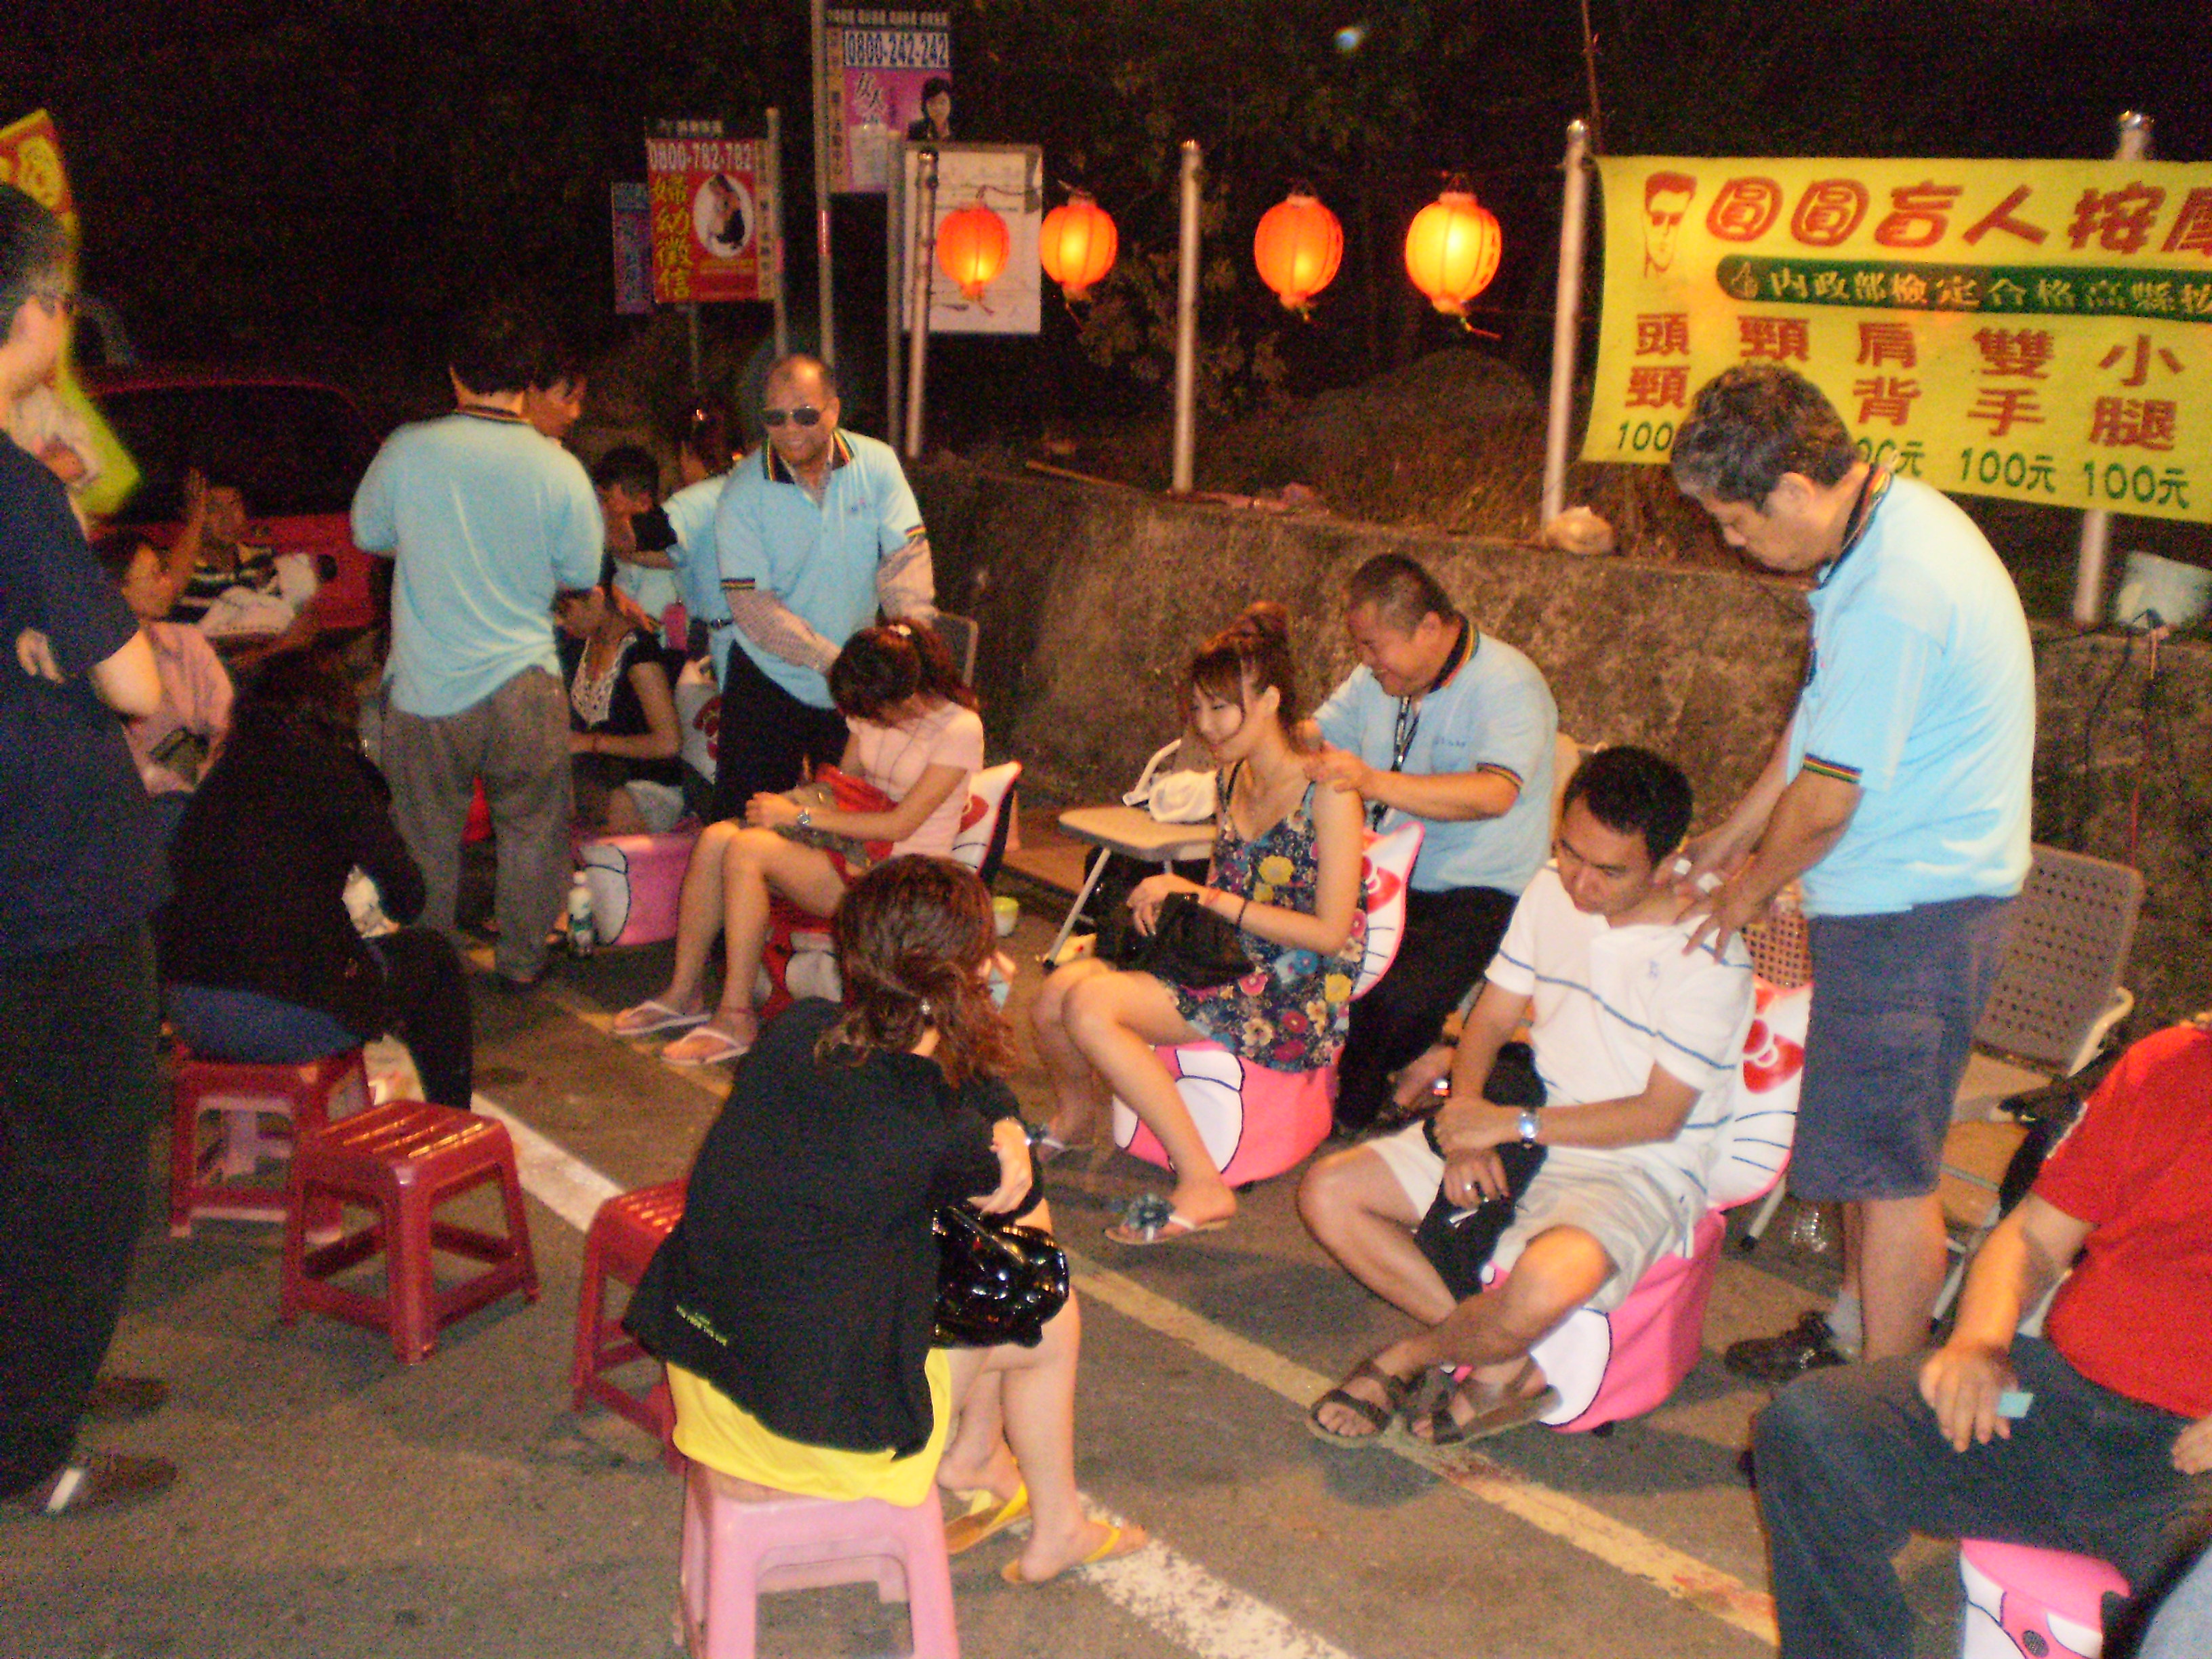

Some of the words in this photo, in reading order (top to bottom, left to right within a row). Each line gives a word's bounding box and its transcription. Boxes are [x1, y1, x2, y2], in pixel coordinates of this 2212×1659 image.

[1967, 327, 2054, 436] 雙手
[2089, 333, 2186, 451] 小腿
[1961, 447, 2056, 493] 100元
[2083, 460, 2189, 509] 100元
